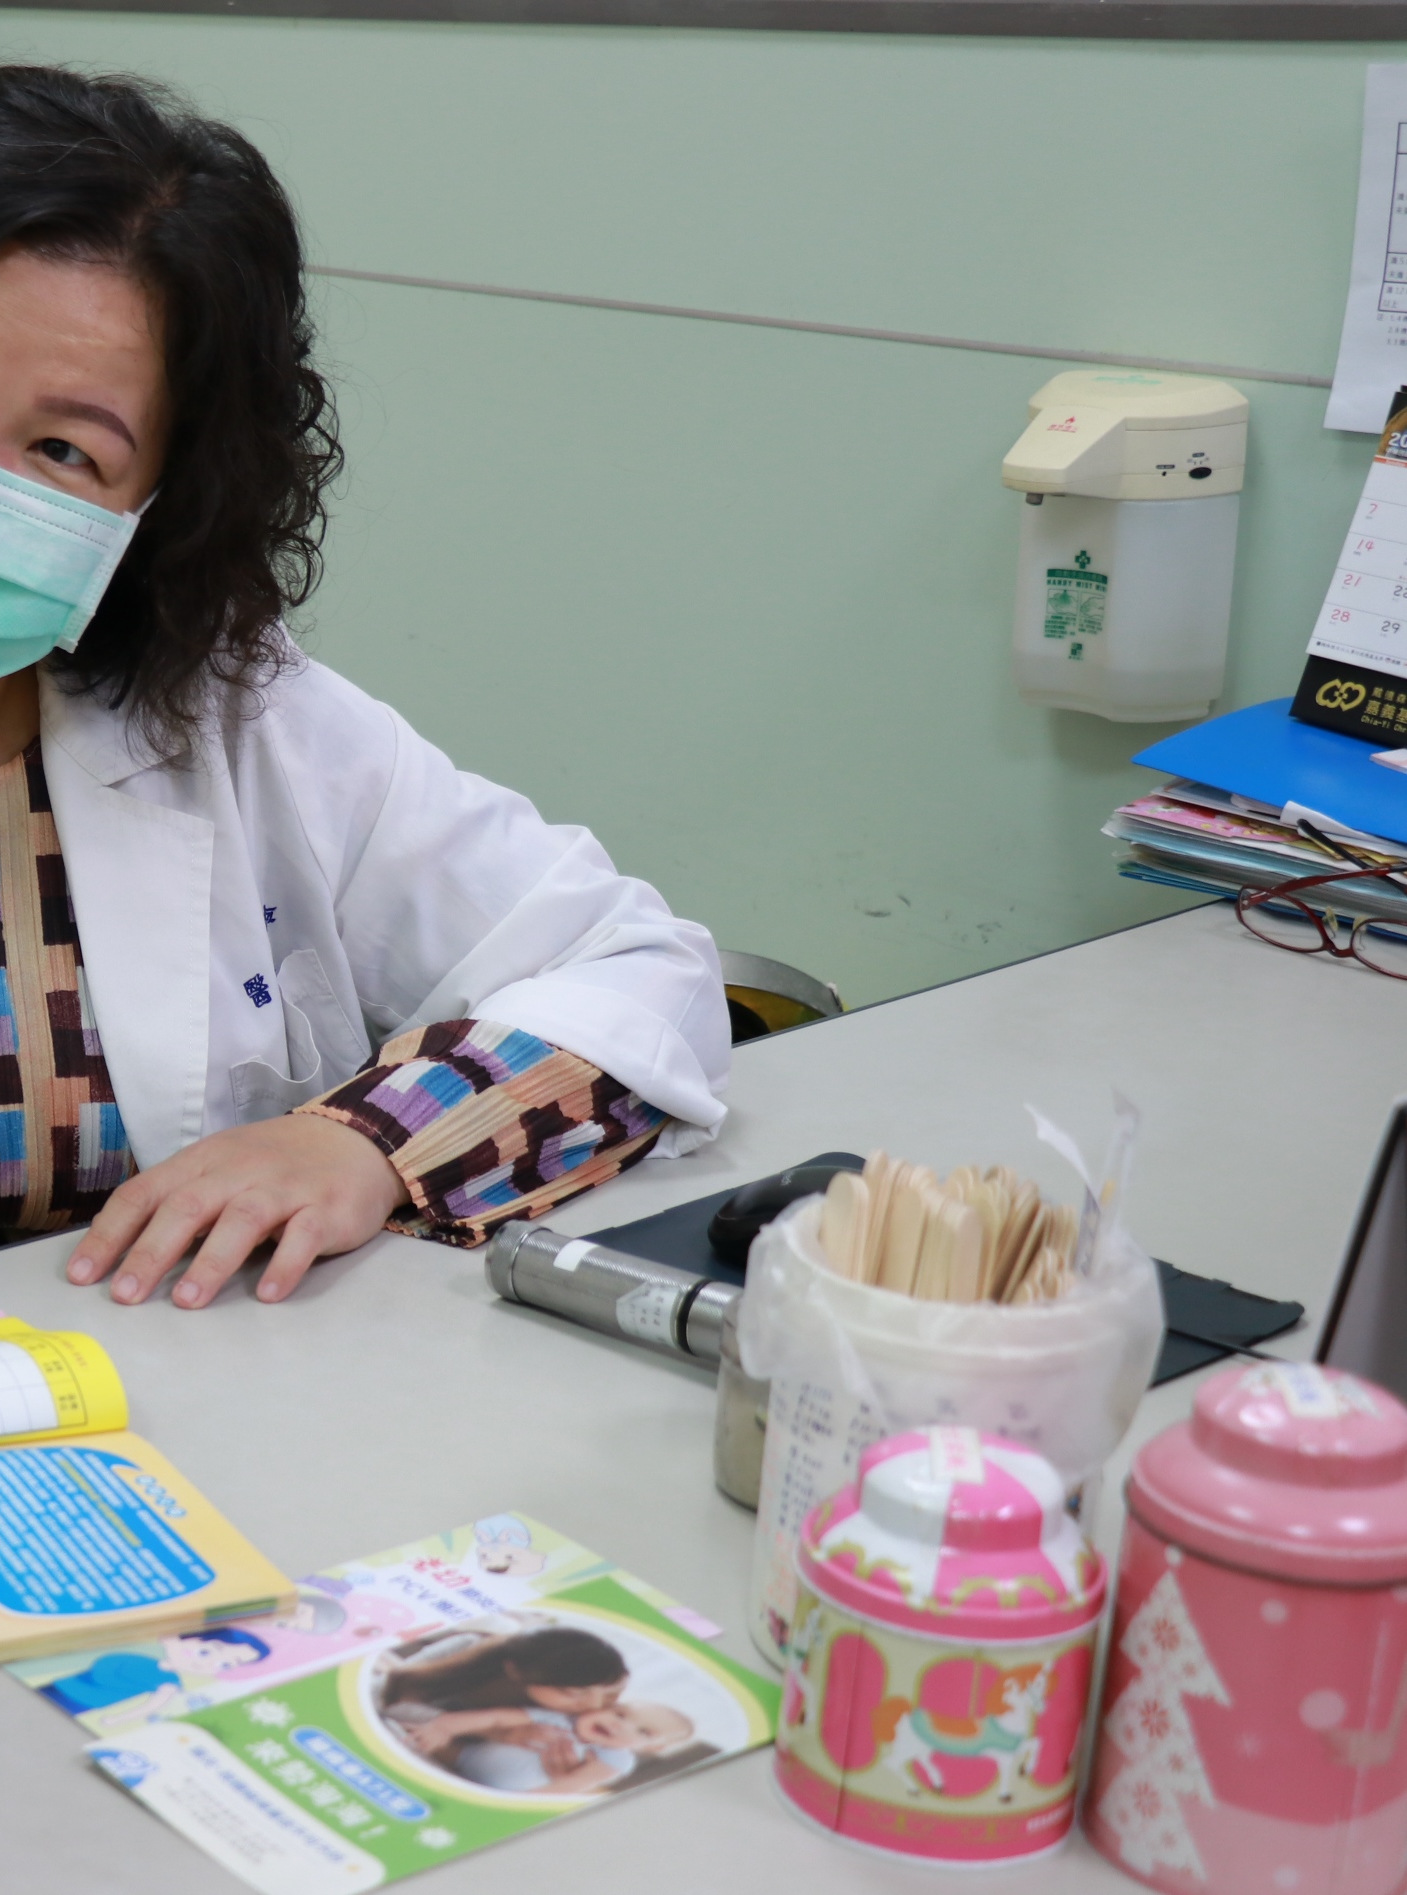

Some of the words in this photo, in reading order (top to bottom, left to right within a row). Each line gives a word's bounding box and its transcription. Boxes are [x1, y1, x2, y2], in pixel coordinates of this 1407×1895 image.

[1368, 503, 1378, 515] 7
[1356, 538, 1375, 552] 14
[1076, 581, 1092, 590] MIST
[1343, 574, 1362, 587] 21
[1331, 608, 1351, 623] 28
[1381, 620, 1401, 635] 29
[1360, 714, 1390, 729] Chia-Yi
